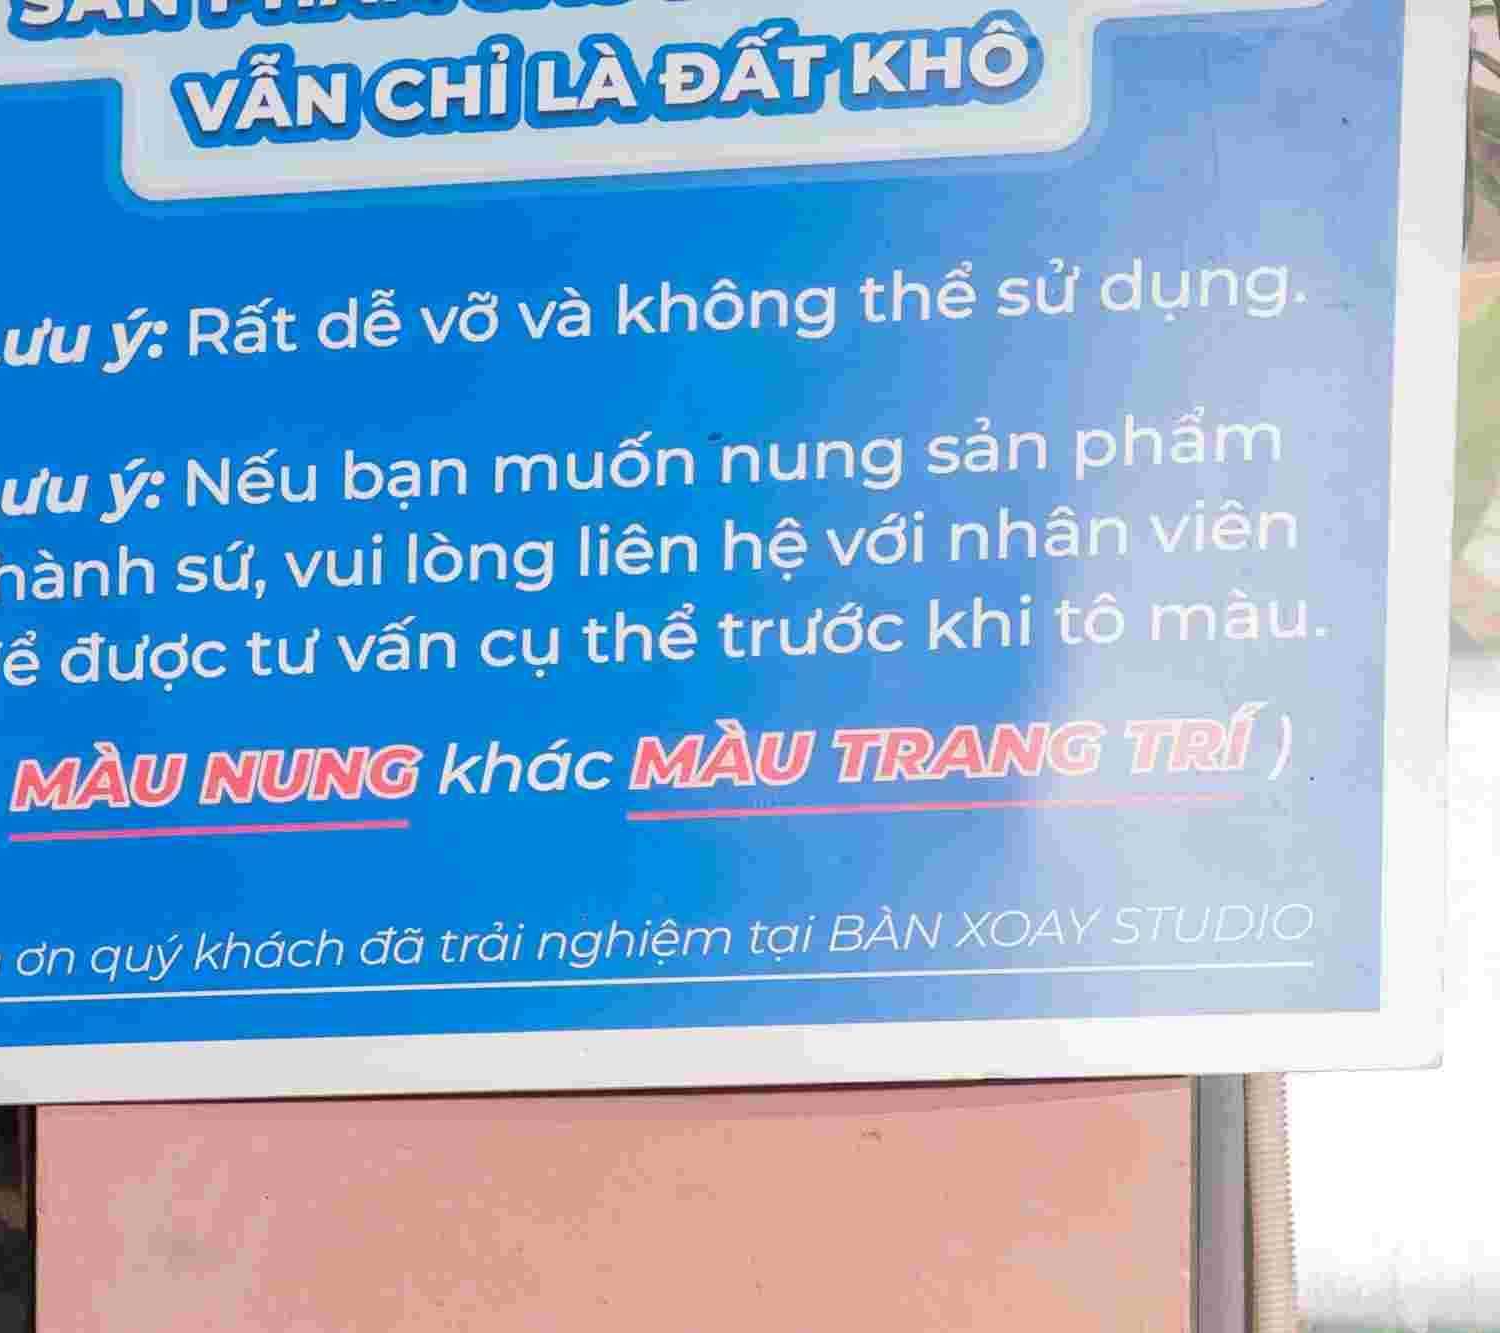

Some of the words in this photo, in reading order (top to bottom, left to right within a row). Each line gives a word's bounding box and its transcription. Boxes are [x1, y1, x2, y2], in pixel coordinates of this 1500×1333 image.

[184, 53, 347, 131] VẪN
[375, 44, 509, 120] CHỈ
[536, 50, 637, 114] LÀ
[659, 27, 827, 104] ĐẤT
[852, 23, 1028, 93] KHÔ
[102, 308, 168, 373] ý:
[189, 298, 297, 355] Rất
[318, 289, 401, 349] dễ
[420, 292, 498, 344] vỡ
[518, 287, 590, 338] và
[618, 278, 835, 338] không
[860, 262, 976, 322] thể
[998, 259, 1079, 316] sử
[1100, 257, 1305, 320] dụng.
[100, 458, 165, 523] ý:
[187, 449, 316, 506] Nếu
[345, 449, 466, 510] bạn
[495, 432, 694, 493] muốn
[721, 439, 902, 489] nung
[927, 417, 1046, 474] sản
[1076, 407, 1280, 480] phẩm
[177, 541, 266, 599] sứ,
[285, 534, 382, 587] vui
[408, 533, 554, 591] lòng
[580, 524, 697, 576] liên
[724, 517, 807, 581] hệ
[826, 511, 924, 566] với
[951, 506, 1126, 560] nhân
[1150, 500, 1296, 552] viên
[61, 632, 226, 691] được
[246, 628, 320, 676] tư
[337, 616, 456, 672] vấn
[481, 628, 559, 678] cụ
[583, 603, 697, 663] thể
[717, 603, 903, 657] trước
[929, 595, 1031, 650] khi
[1054, 595, 1125, 645] tô
[1149, 589, 1328, 644] màu.
[9, 741, 188, 812] MÀU
[199, 745, 424, 805] NUNG
[439, 739, 613, 794] khác
[628, 718, 817, 790] MÀU
[832, 721, 1103, 785] TRANG
[1124, 702, 1268, 774] TRÍ
[17, 943, 75, 976] ơn
[91, 935, 183, 982] quý
[195, 929, 343, 970] khách
[360, 927, 424, 965] đã
[442, 922, 524, 962] trải
[538, 919, 731, 968] nghiệm
[750, 915, 815, 961] tại
[828, 905, 942, 952] BÀN
[955, 909, 1100, 947] XOAY
[1111, 904, 1313, 944] STUDIO
